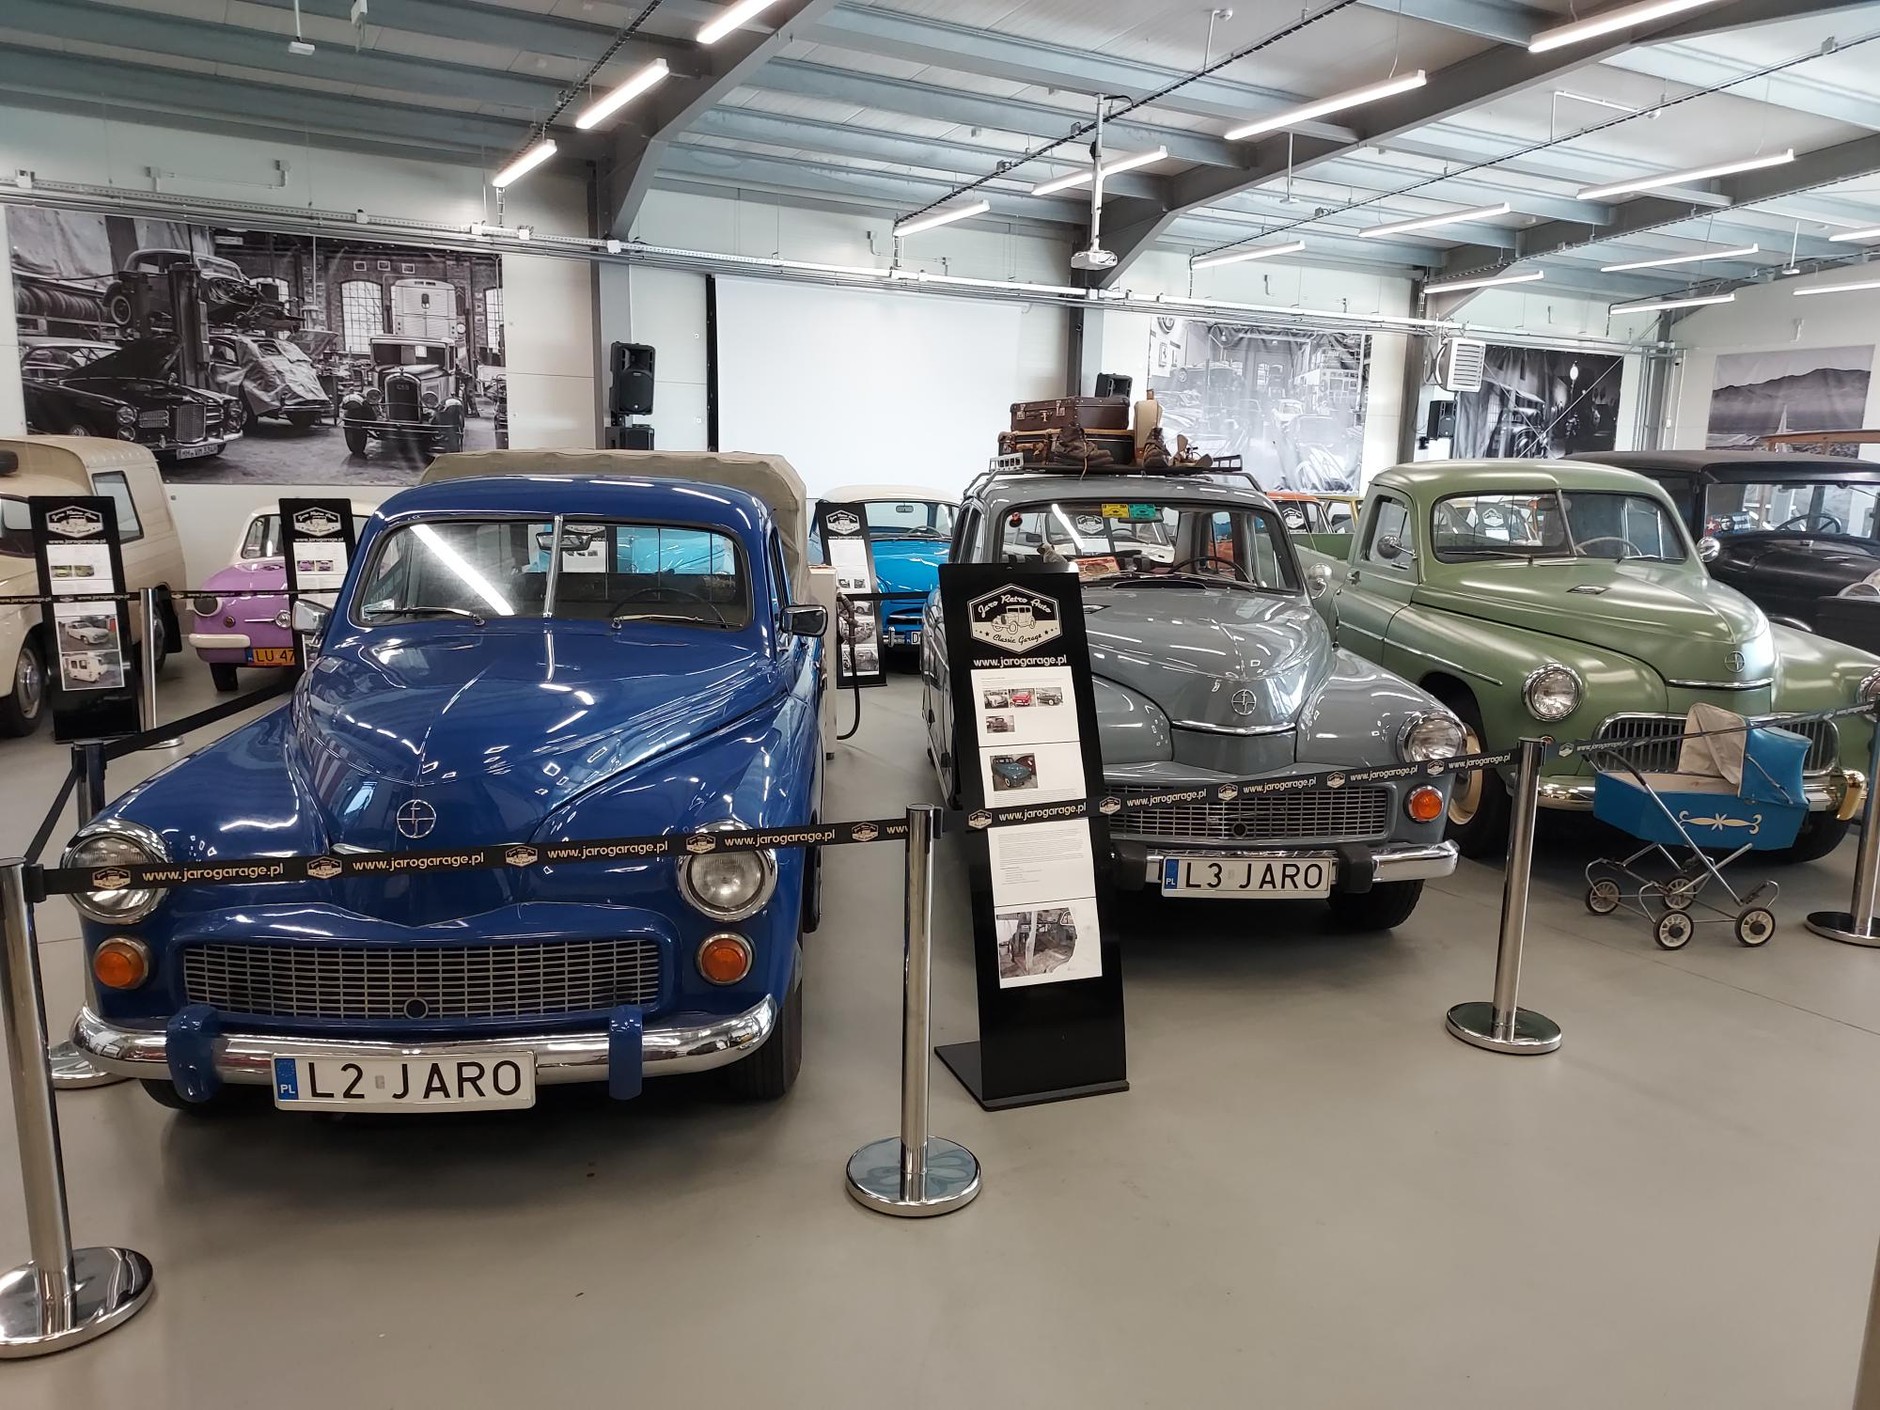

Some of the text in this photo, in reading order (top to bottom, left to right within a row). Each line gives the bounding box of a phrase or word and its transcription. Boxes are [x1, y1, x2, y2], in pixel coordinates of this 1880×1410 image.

[978, 594, 1052, 618] Jaro Retro Auto
[993, 633, 1042, 646] Classic Garage
[255, 650, 275, 662] LU
[973, 654, 1067, 668] www.jarogarage.pl
[1448, 752, 1512, 770] www.jarogarage.pl
[1350, 765, 1419, 783] www.jarogarage.pl
[1243, 776, 1318, 795] www.jarogarage.pl
[1126, 788, 1208, 808] www.jarogarage.pl
[998, 802, 1088, 822] www.jarogarage.pl
[724, 829, 836, 848] www.jarogarage.pl
[547, 841, 669, 860] www.jarogarage.pl
[353, 852, 485, 872] www.jarogarage.pl
[142, 862, 284, 883] www.jarogarage.pl
[1165, 862, 1323, 890] PL L3 JARO
[280, 1059, 522, 1100] PL L2 JARO
